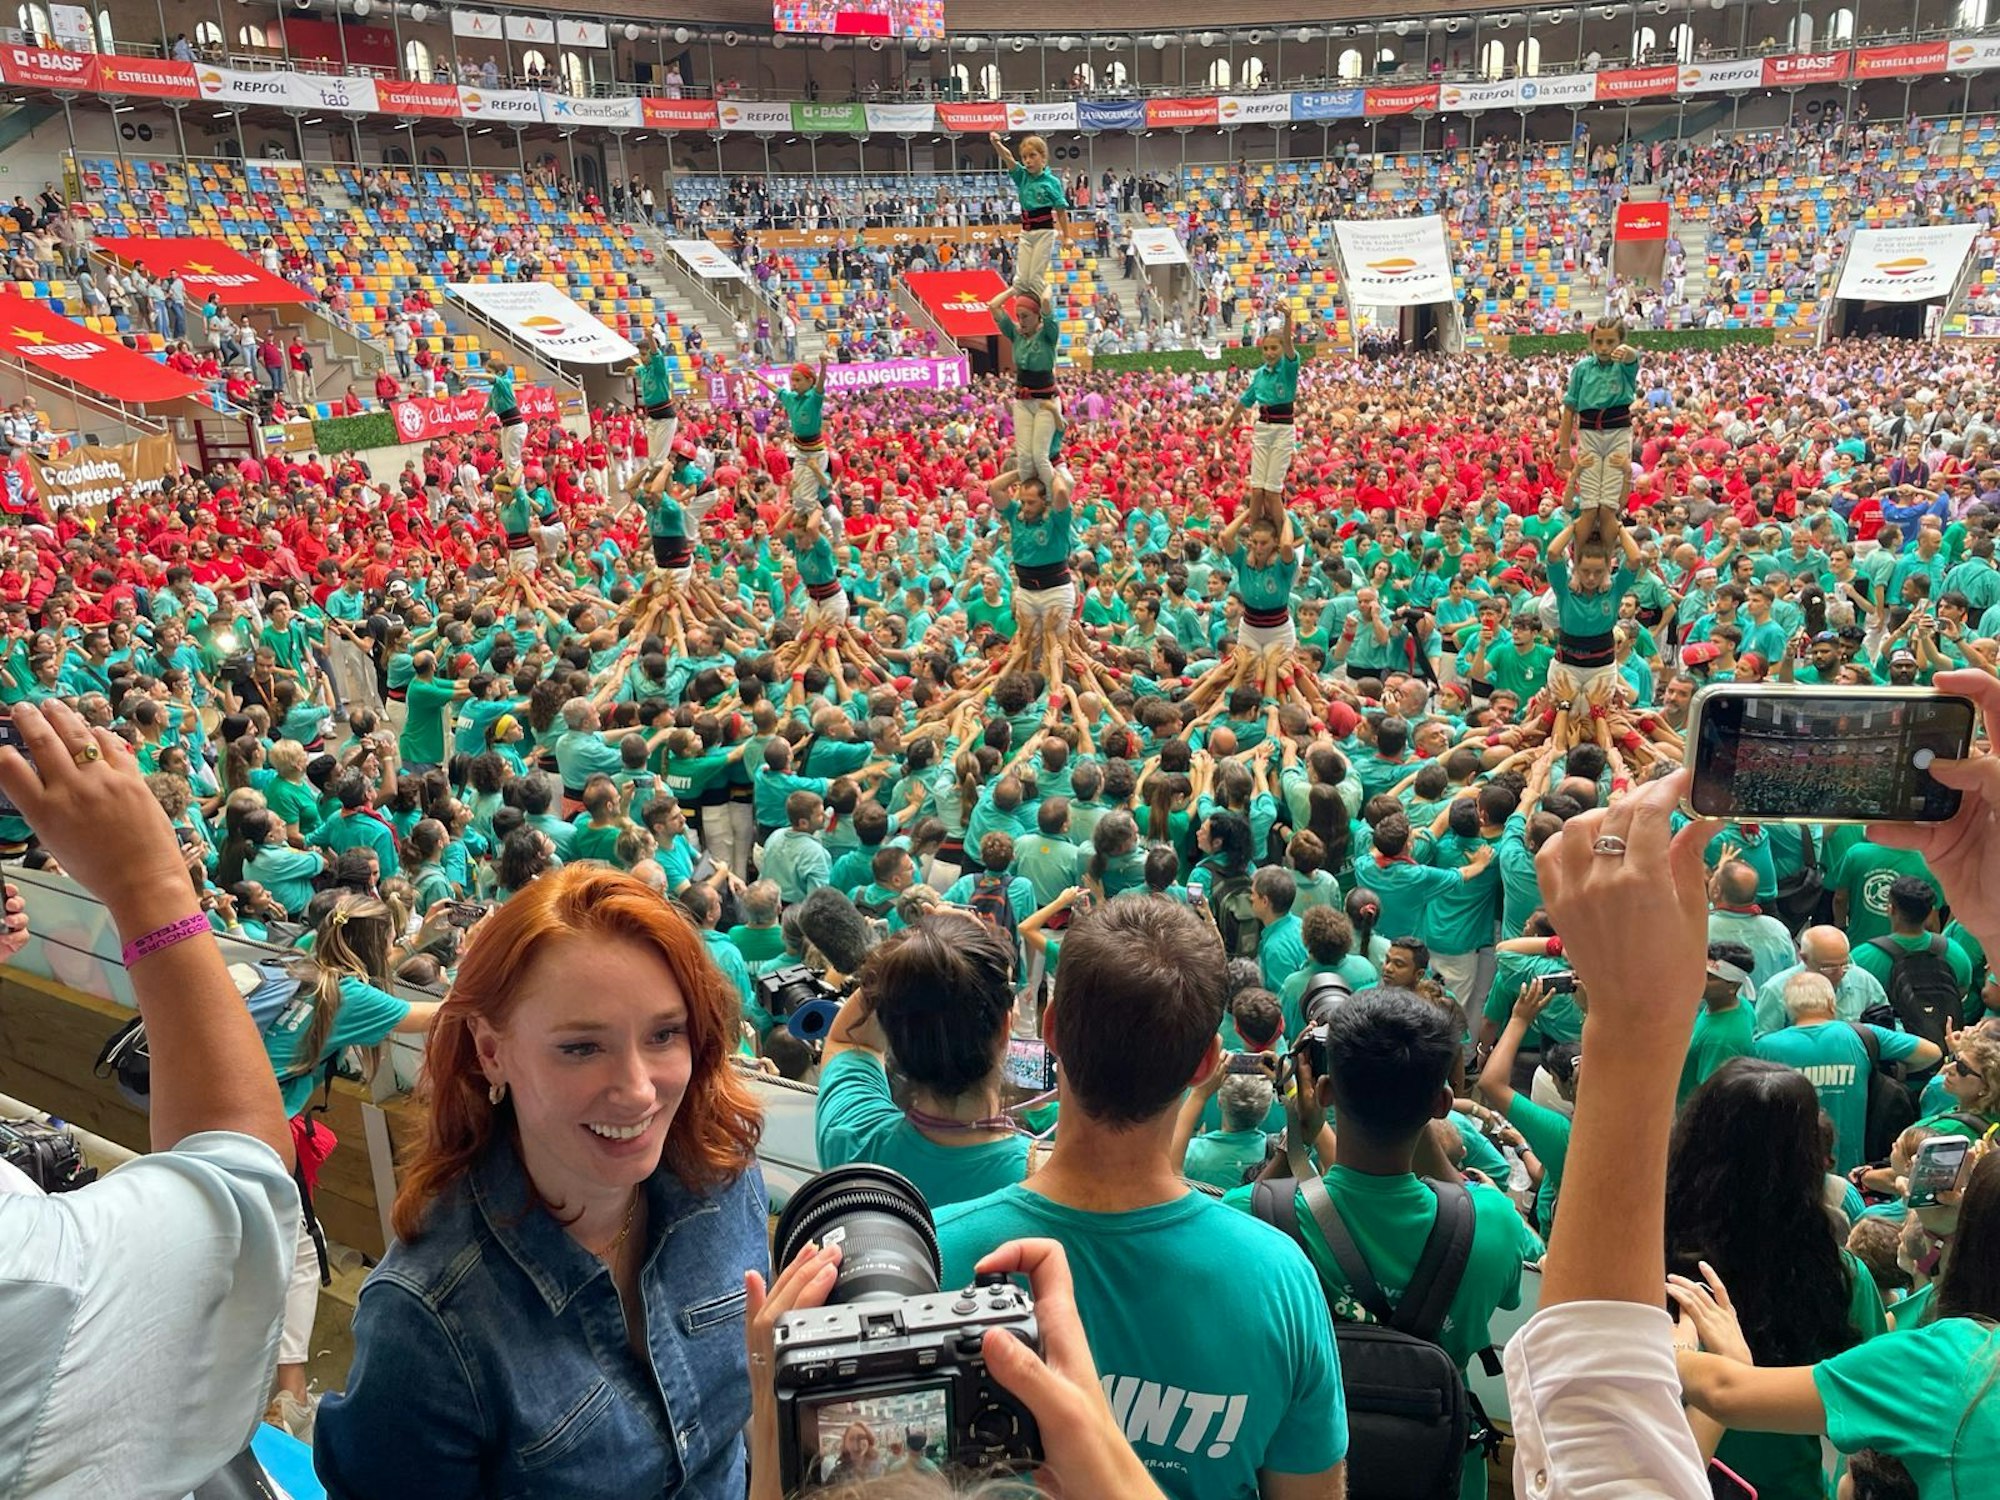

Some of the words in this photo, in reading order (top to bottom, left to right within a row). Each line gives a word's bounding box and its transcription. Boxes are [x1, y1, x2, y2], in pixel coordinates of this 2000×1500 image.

[37, 53, 84, 71] BASF
[1796, 55, 1836, 70] BASF
[1870, 58, 1913, 69] ESTRELLA
[1915, 54, 1945, 65] DAMM
[117, 71, 165, 84] ESTRELLA
[166, 75, 196, 87] DAMM
[1709, 69, 1760, 81] REPSOL
[233, 80, 287, 94] REPSOL
[1539, 84, 1550, 96] la
[1609, 79, 1649, 91] ESTRELLA
[1649, 77, 1676, 88] DAMM
[320, 89, 350, 107] tac
[390, 94, 431, 105] ESTRELLA
[431, 96, 459, 107] DAMM
[1320, 93, 1354, 105] BASF
[1469, 89, 1515, 101] REPSOL
[491, 100, 539, 112] REPSOL
[1246, 103, 1288, 114] REPSOL
[1377, 97, 1414, 108] ESTRELLA
[572, 103, 631, 118] CaixaBank
[655, 110, 692, 120] ESTRELLA
[821, 106, 853, 118] BASF
[1033, 112, 1075, 121] REPSOL
[1158, 110, 1193, 119] ESTRELLA
[747, 112, 790, 122] REPSOL
[947, 114, 982, 122] ESTRELLA
[982, 114, 1006, 122] DAMM
[180, 274, 260, 283] ESTRELLA
[1361, 273, 1439, 284] REPSOL
[1860, 275, 1937, 285] REPSOL
[534, 333, 602, 346] REPSOL
[15, 341, 108, 356] ESTRELLA
[824, 365, 932, 387] XIGANGUERS
[453, 407, 478, 422] Joves
[520, 401, 532, 414] de
[134, 914, 204, 948] CASTELLS
[138, 922, 203, 955] CONCURS
[1099, 1373, 1249, 1459] UNT!
